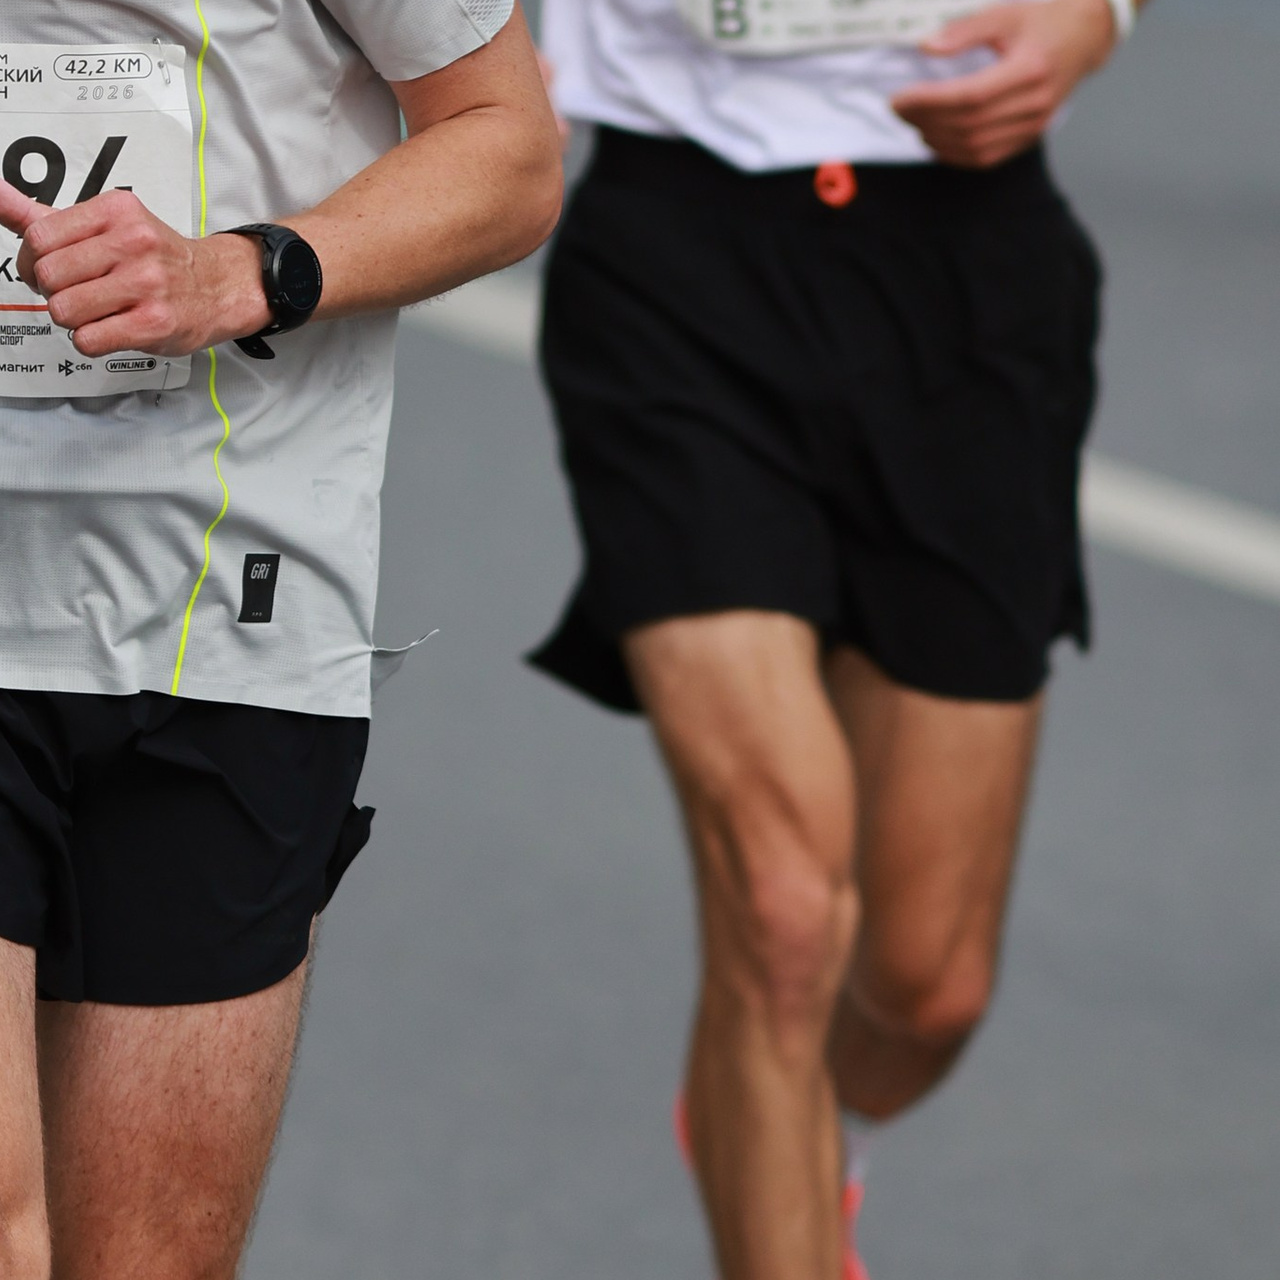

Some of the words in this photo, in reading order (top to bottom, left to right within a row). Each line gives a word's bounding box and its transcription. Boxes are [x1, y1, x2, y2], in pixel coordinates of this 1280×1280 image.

[64, 59, 106, 77] 42,2
[77, 85, 134, 100] 2026
[0, 323, 52, 336] МОСКОВСКИЙ
[0, 335, 24, 346] СПОРТ
[109, 360, 146, 370] WINLINE
